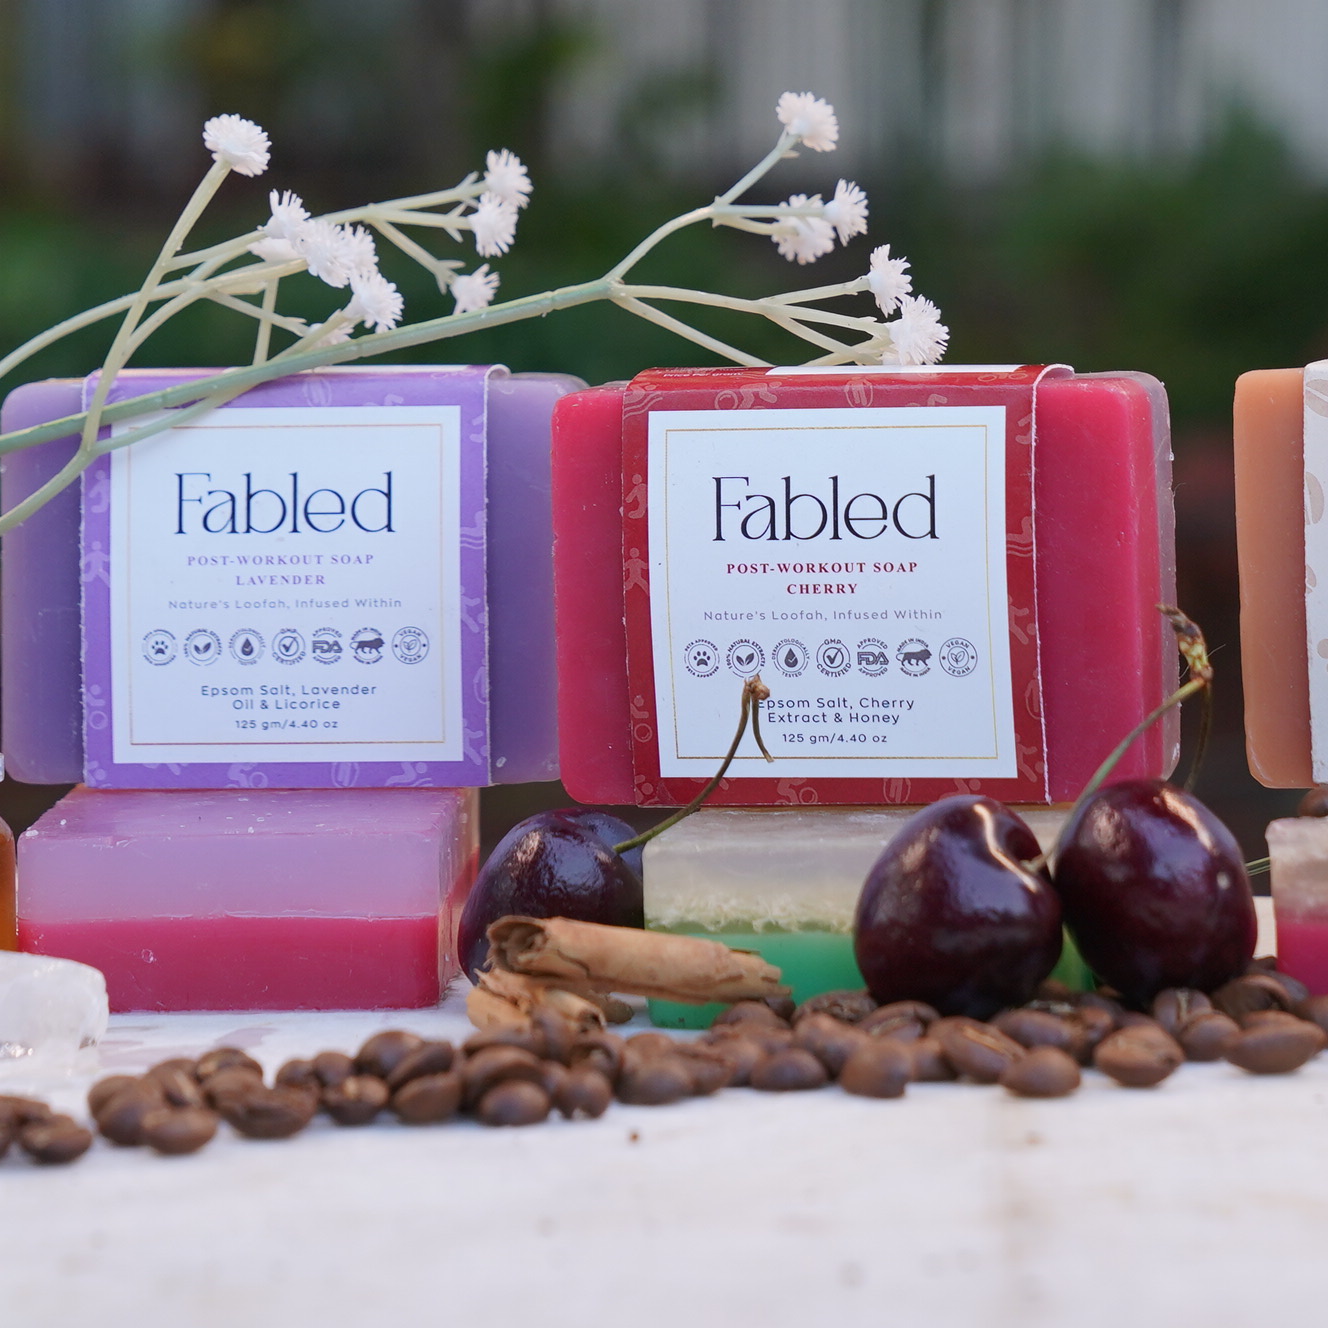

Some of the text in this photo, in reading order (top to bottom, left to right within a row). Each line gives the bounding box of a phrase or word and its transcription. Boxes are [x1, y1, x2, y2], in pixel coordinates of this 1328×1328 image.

[175, 471, 395, 534] Fabled
[712, 474, 939, 541] Fabled
[188, 555, 373, 566] POST-WORKOUT SOAP
[727, 562, 917, 574] POST-WORKOUT SOAP
[236, 575, 325, 585] LAVENDER
[787, 584, 857, 594] CHERRY
[169, 598, 401, 609] Nature's Loofah, Infused Within
[704, 609, 941, 621] Nature's Loofah, Infused Within
[312, 640, 343, 654] FDA
[695, 639, 718, 651] APPROVED
[772, 638, 810, 660] DERMATOLOGICALLY
[857, 638, 888, 650] APPROVED
[897, 640, 907, 652] MADE
[915, 638, 929, 648] INDIA
[946, 640, 969, 649] VEGAN
[728, 639, 750, 652] NATURAL
[752, 641, 765, 667] EXTRACTS
[857, 651, 889, 665] FDA
[816, 663, 852, 678] CERTIFIED
[858, 667, 888, 678] APPROVED
[948, 666, 971, 675] VEGAN
[201, 685, 376, 697] Epsom Salt, Lavender
[233, 699, 340, 710] Oil & Licorice
[817, 697, 852, 709] Salt,
[860, 697, 914, 710] Cherry
[768, 712, 899, 725] Extract & Honey
[235, 720, 256, 729] 125
[262, 720, 318, 730] gm/4.40
[783, 734, 804, 742] 125
[810, 733, 866, 744] gm/4.40
